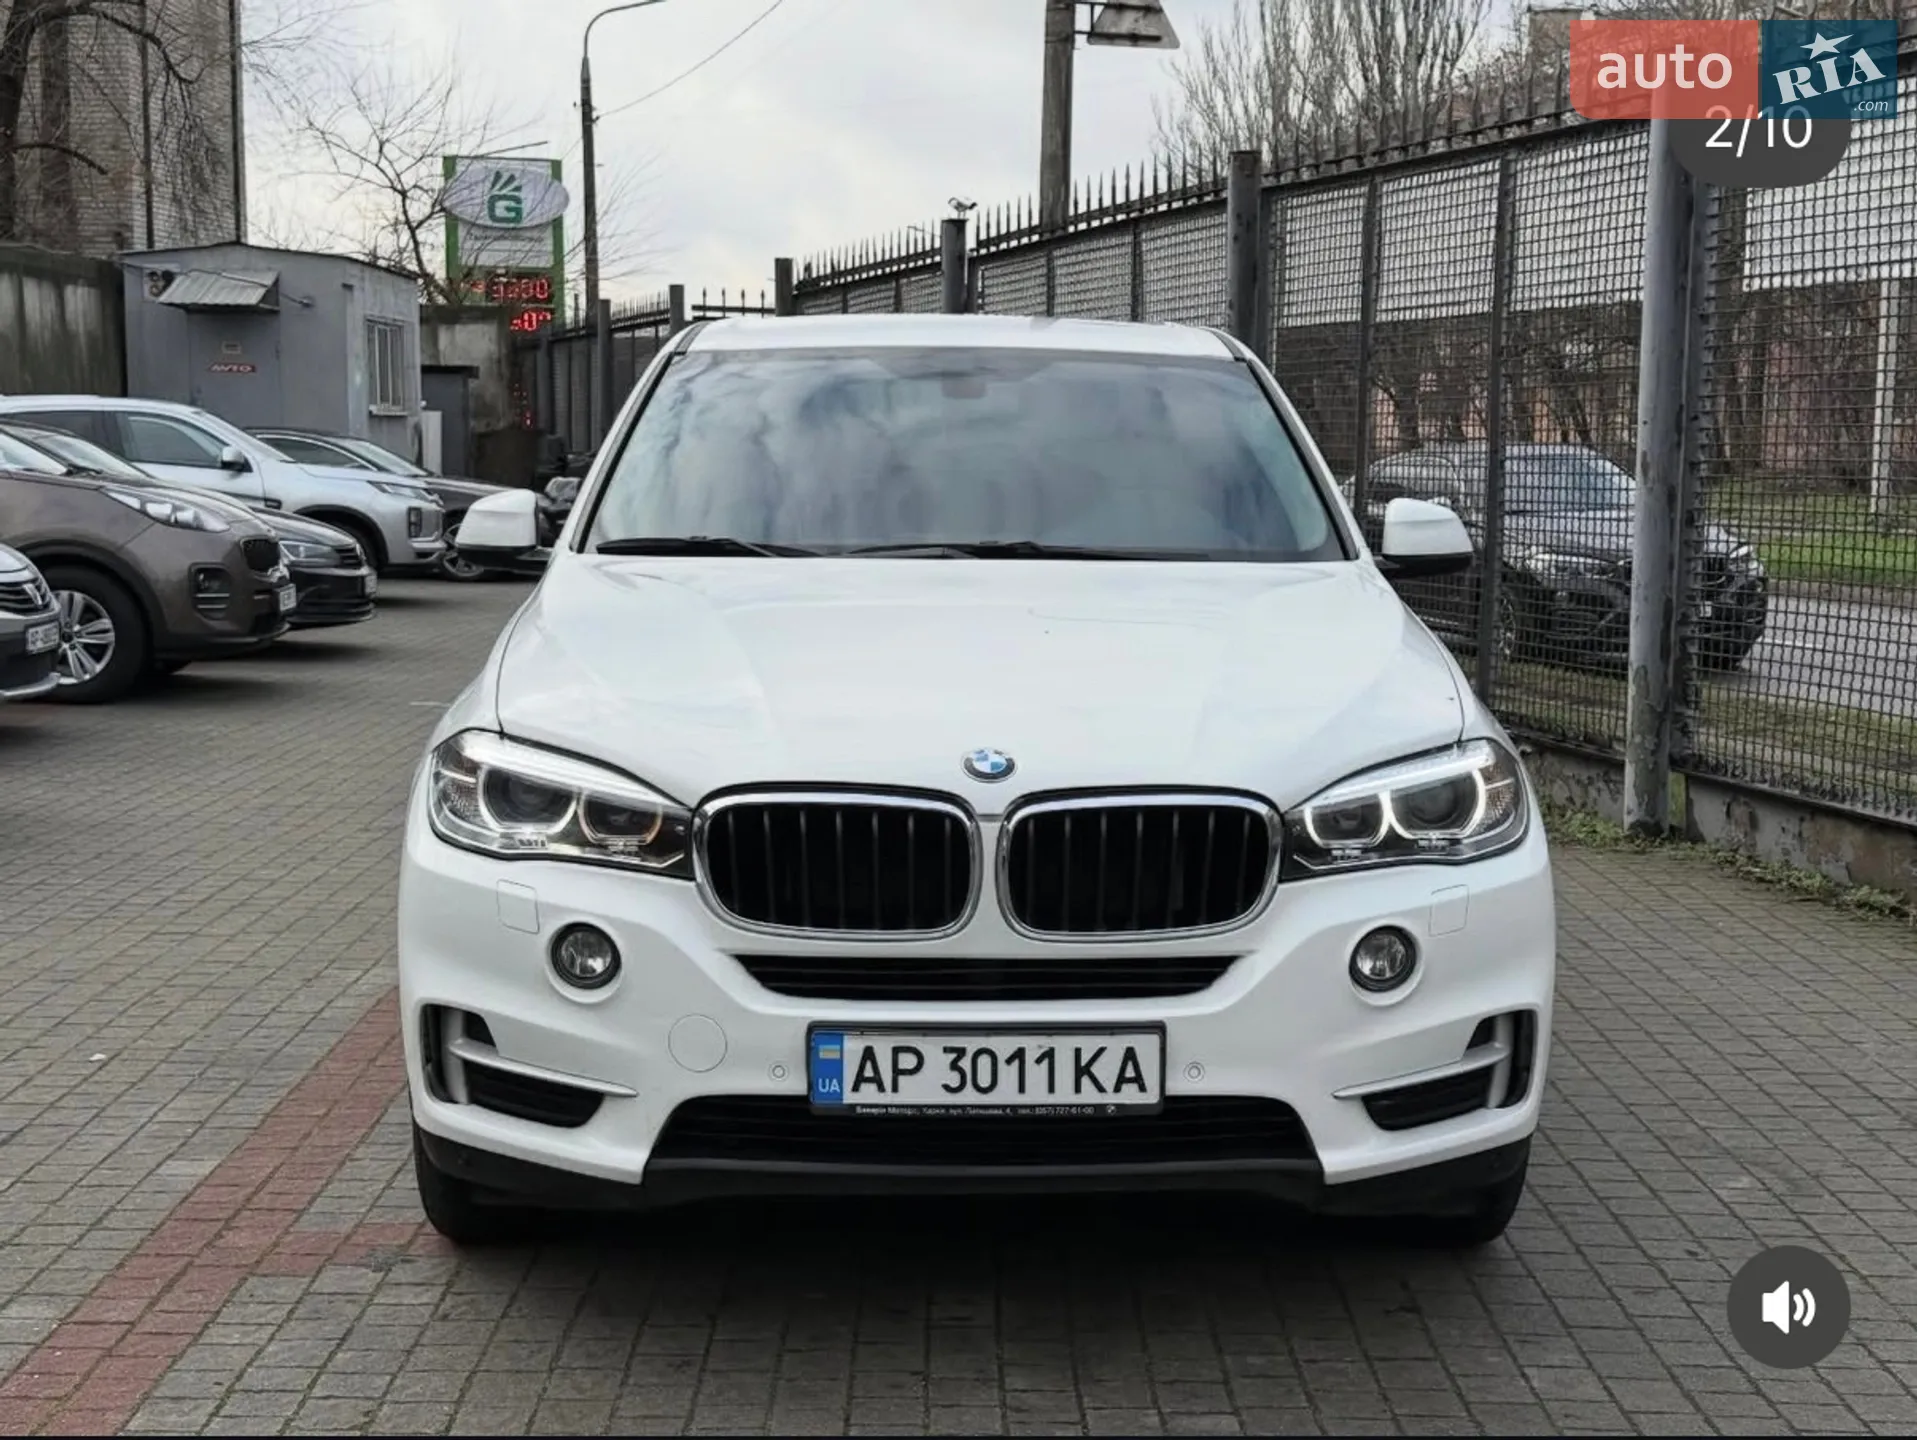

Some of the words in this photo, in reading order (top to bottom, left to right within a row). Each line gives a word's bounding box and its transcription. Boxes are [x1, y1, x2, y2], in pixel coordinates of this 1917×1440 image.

[818, 1078, 840, 1093] UA
[851, 1045, 925, 1094] AP
[941, 1046, 1055, 1095] 3011
[1074, 1046, 1148, 1094] KA
